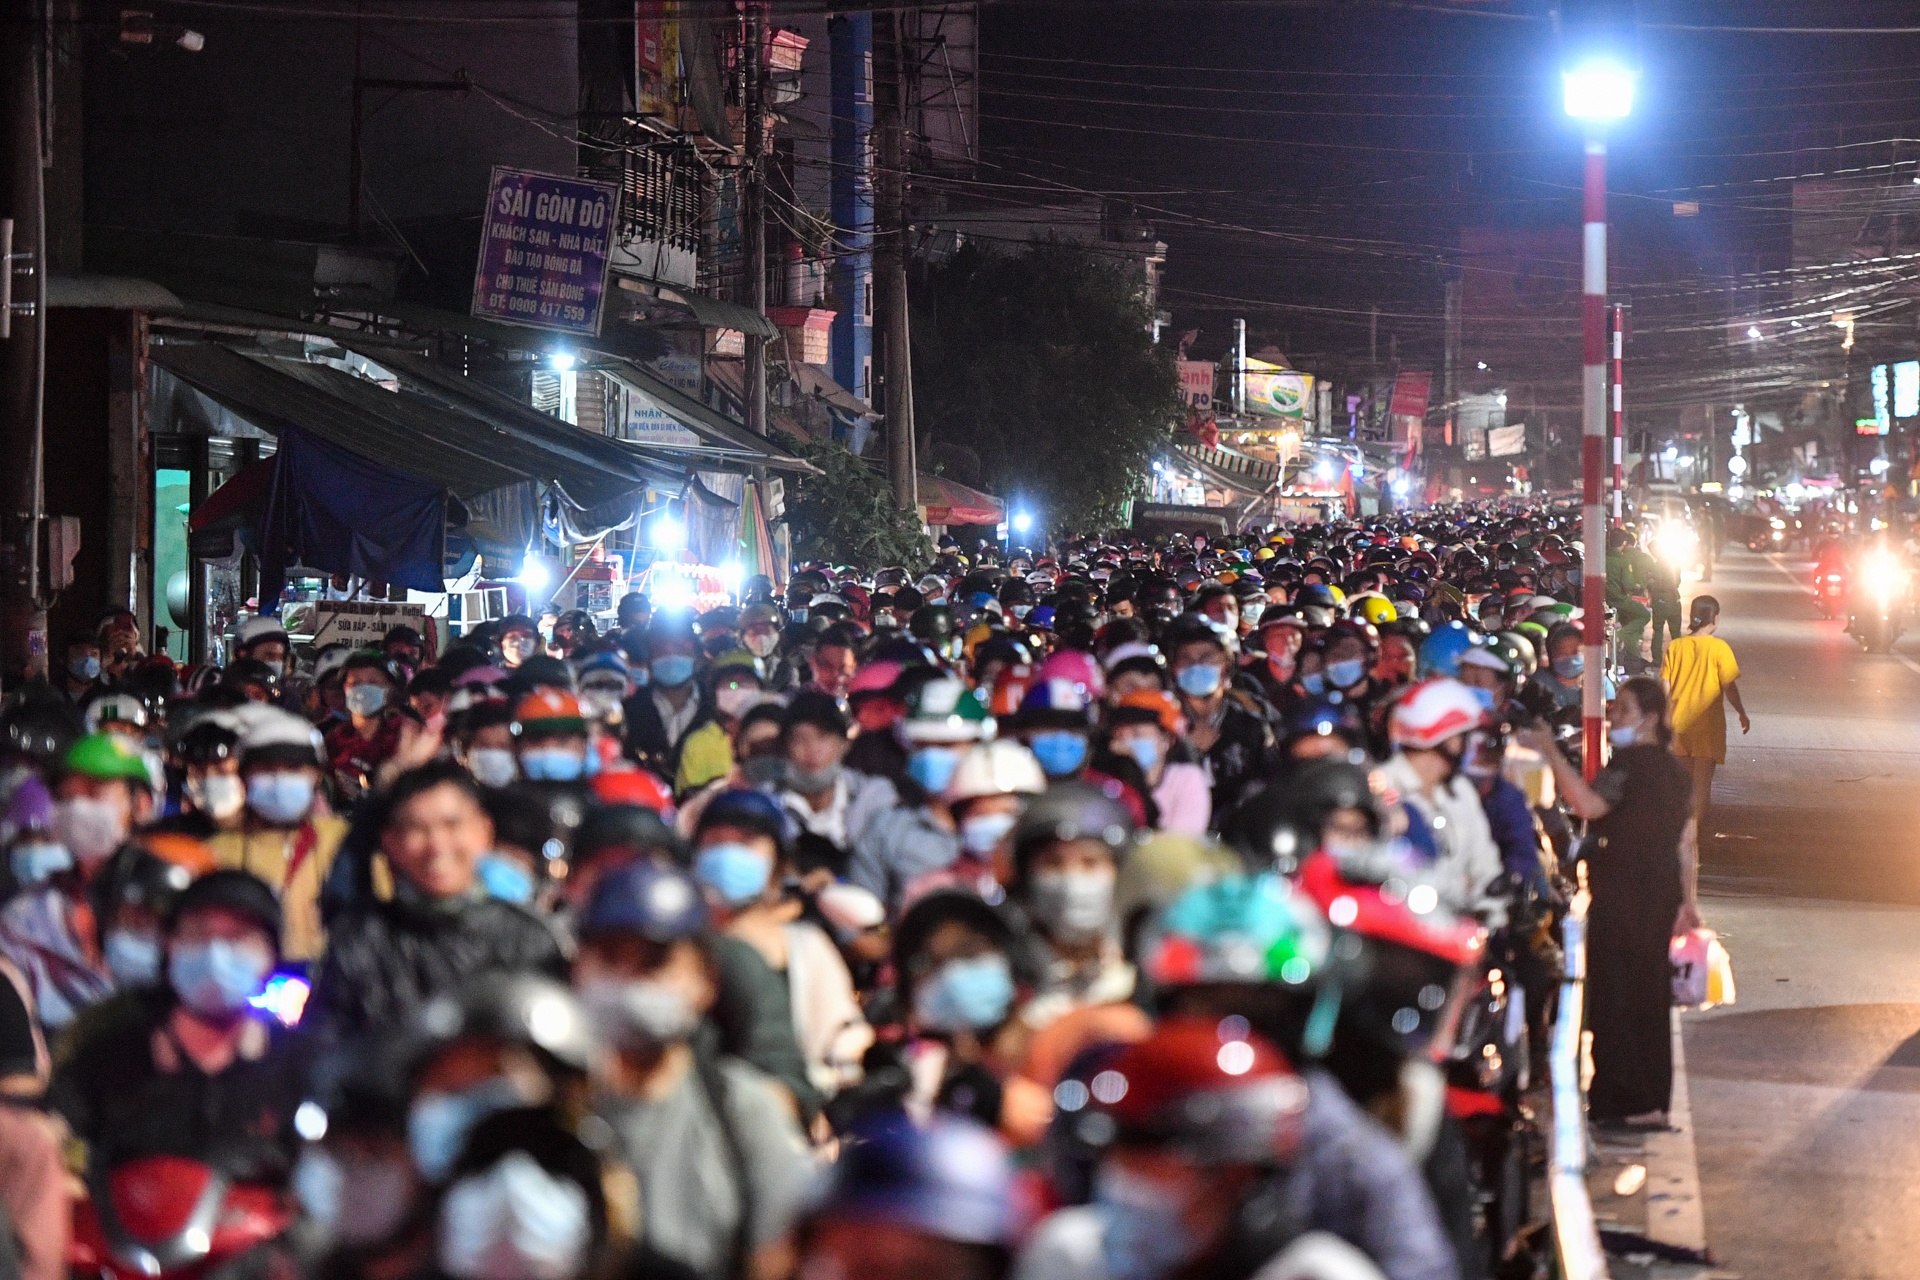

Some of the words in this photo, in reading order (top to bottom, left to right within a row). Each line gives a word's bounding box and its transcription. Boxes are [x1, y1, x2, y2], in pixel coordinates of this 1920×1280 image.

[499, 183, 531, 218] SÀI
[535, 188, 576, 224] GÒN
[579, 196, 605, 229] ĐÔ
[491, 220, 527, 242] KHÁCH
[529, 229, 550, 248] SẠN
[559, 231, 580, 250] NHÀ
[583, 232, 602, 252] ĐẤT
[526, 252, 542, 270] TẠO
[544, 253, 568, 273] BÓNG
[570, 256, 582, 275] ĐÁ
[496, 274, 513, 290] CHO
[516, 276, 538, 294] THUÊ
[539, 278, 559, 298] SÂN
[559, 281, 585, 301] BÓNG
[490, 293, 506, 309] ĐT:
[509, 296, 538, 314] 0908
[540, 301, 562, 317] 417
[563, 305, 586, 321] 559
[1181, 369, 1210, 386] ành
[634, 408, 662, 419] NHẬN
